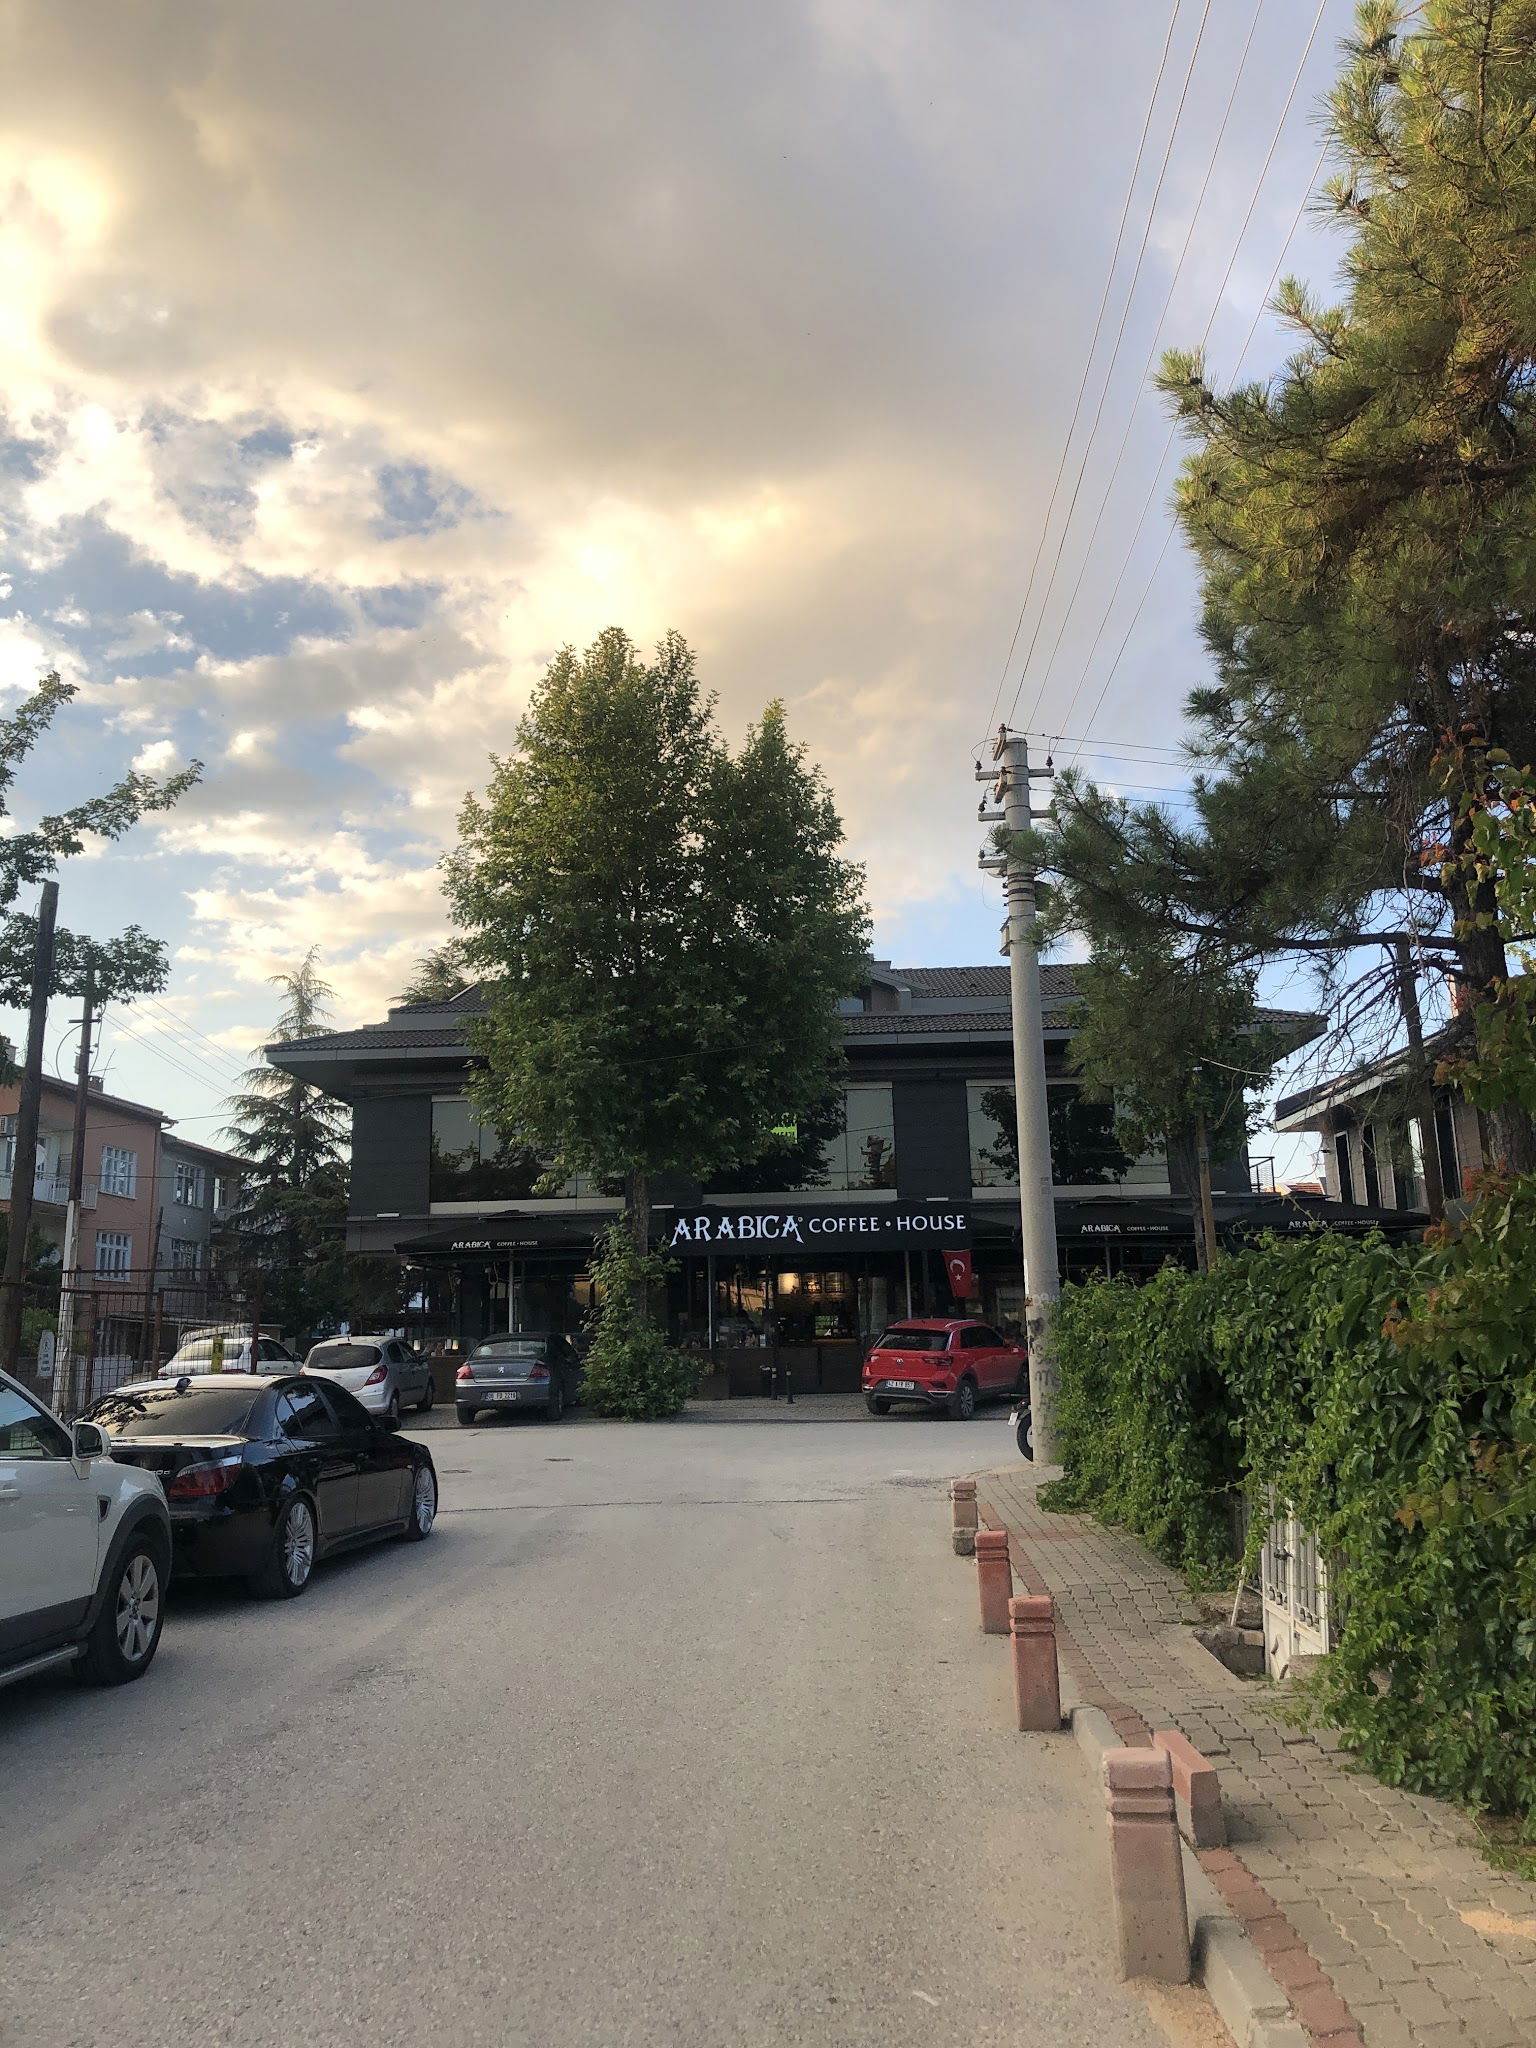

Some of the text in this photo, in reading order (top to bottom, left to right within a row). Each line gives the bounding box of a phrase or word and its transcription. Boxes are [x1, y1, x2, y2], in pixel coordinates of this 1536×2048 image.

[669, 1215, 966, 1247] ARABICA COFFEE HOUSE
[1081, 1224, 1121, 1233] ARABICA
[451, 1241, 491, 1251] ARABICA
